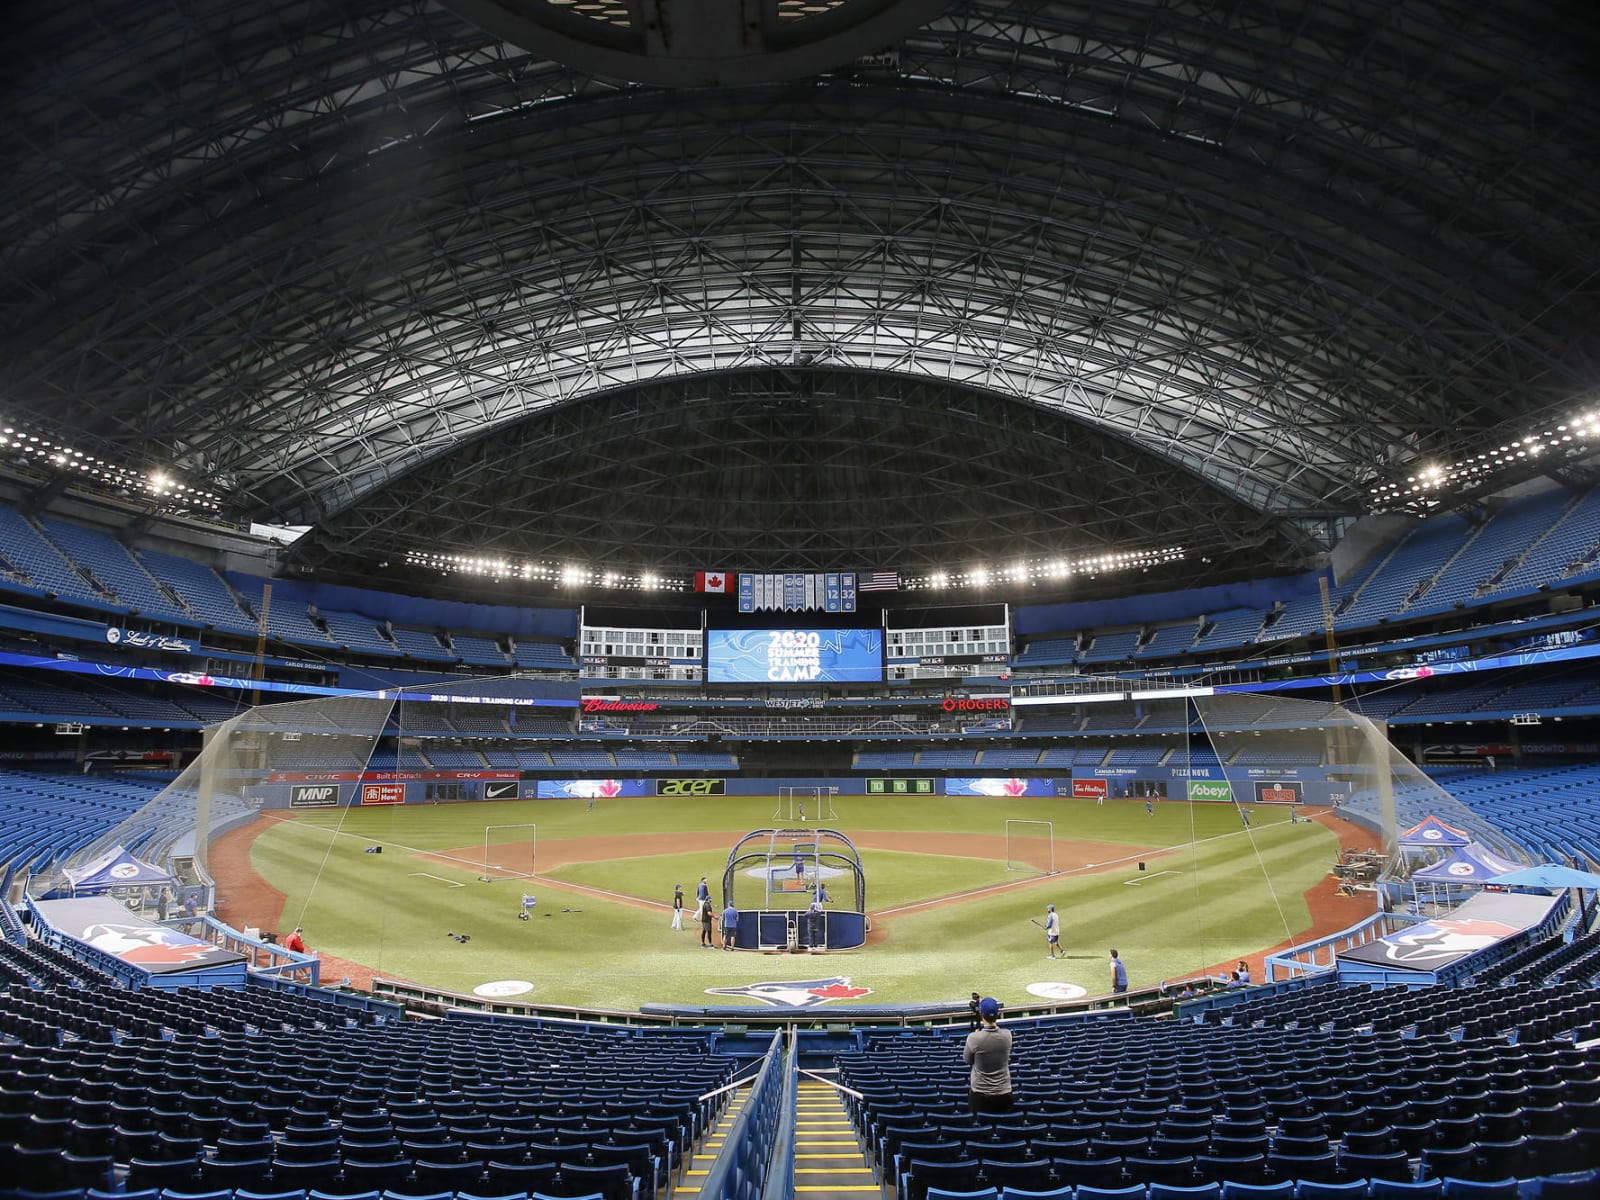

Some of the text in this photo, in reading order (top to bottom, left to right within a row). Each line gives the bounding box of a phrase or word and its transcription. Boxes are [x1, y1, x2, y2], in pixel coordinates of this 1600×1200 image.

[827, 589, 839, 599] 12
[842, 589, 855, 599] 32
[768, 631, 820, 648] 2020
[767, 648, 820, 658] SUMMER
[768, 657, 820, 667] TRAINING
[767, 666, 821, 681] CAMP
[582, 699, 658, 712] Budweiser
[959, 698, 1009, 710] ROGERS
[1171, 768, 1210, 777] PIZZA NOVA
[662, 780, 720, 794] acer
[874, 781, 882, 790] TD
[897, 781, 906, 790] TD
[919, 781, 928, 790] TD
[1189, 784, 1229, 797] Sobeys
[297, 788, 333, 801] MNP
